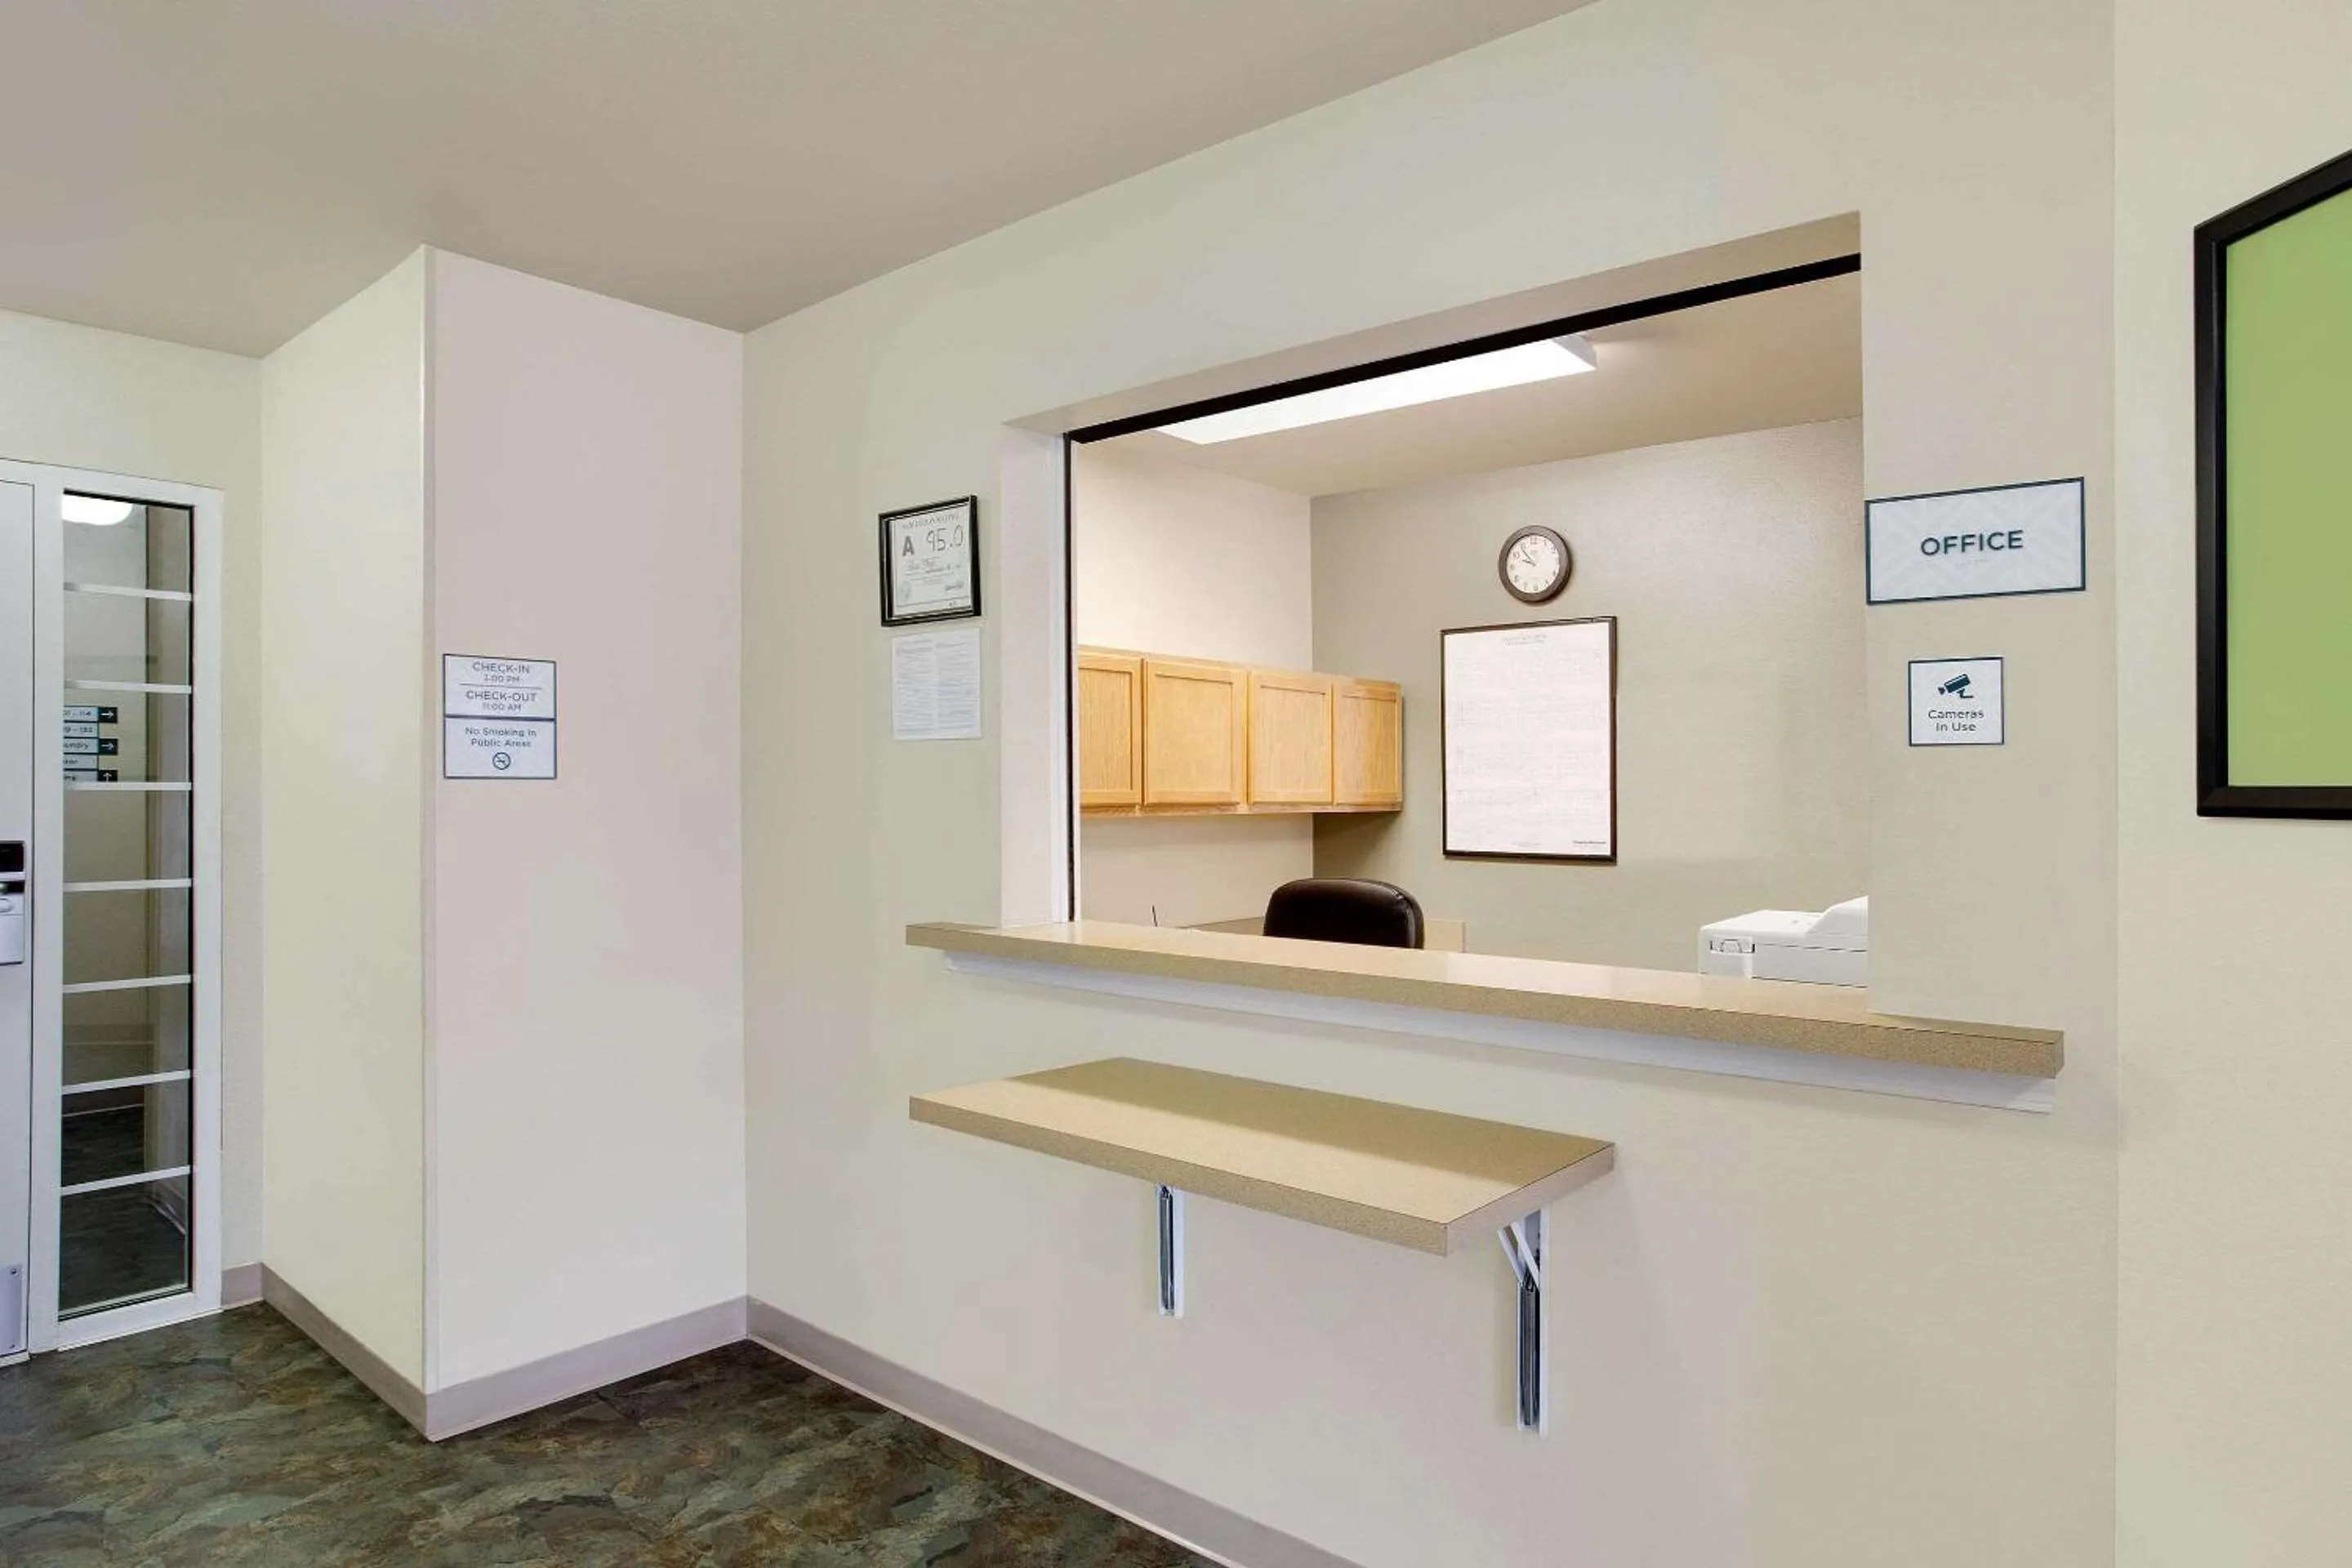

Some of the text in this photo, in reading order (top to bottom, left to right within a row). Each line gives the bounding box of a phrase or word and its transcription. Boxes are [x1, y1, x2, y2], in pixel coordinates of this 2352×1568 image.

[902, 524, 964, 557] A 95.0
[1920, 530, 2024, 556] OFFICE
[472, 661, 531, 674] CHECK-IN
[465, 690, 537, 702] CHECK-OUT
[1928, 710, 1984, 719] Cameras
[465, 726, 480, 736] No
[483, 727, 525, 737] Smoking
[1951, 722, 1977, 732] Use
[470, 737, 502, 748] Public
